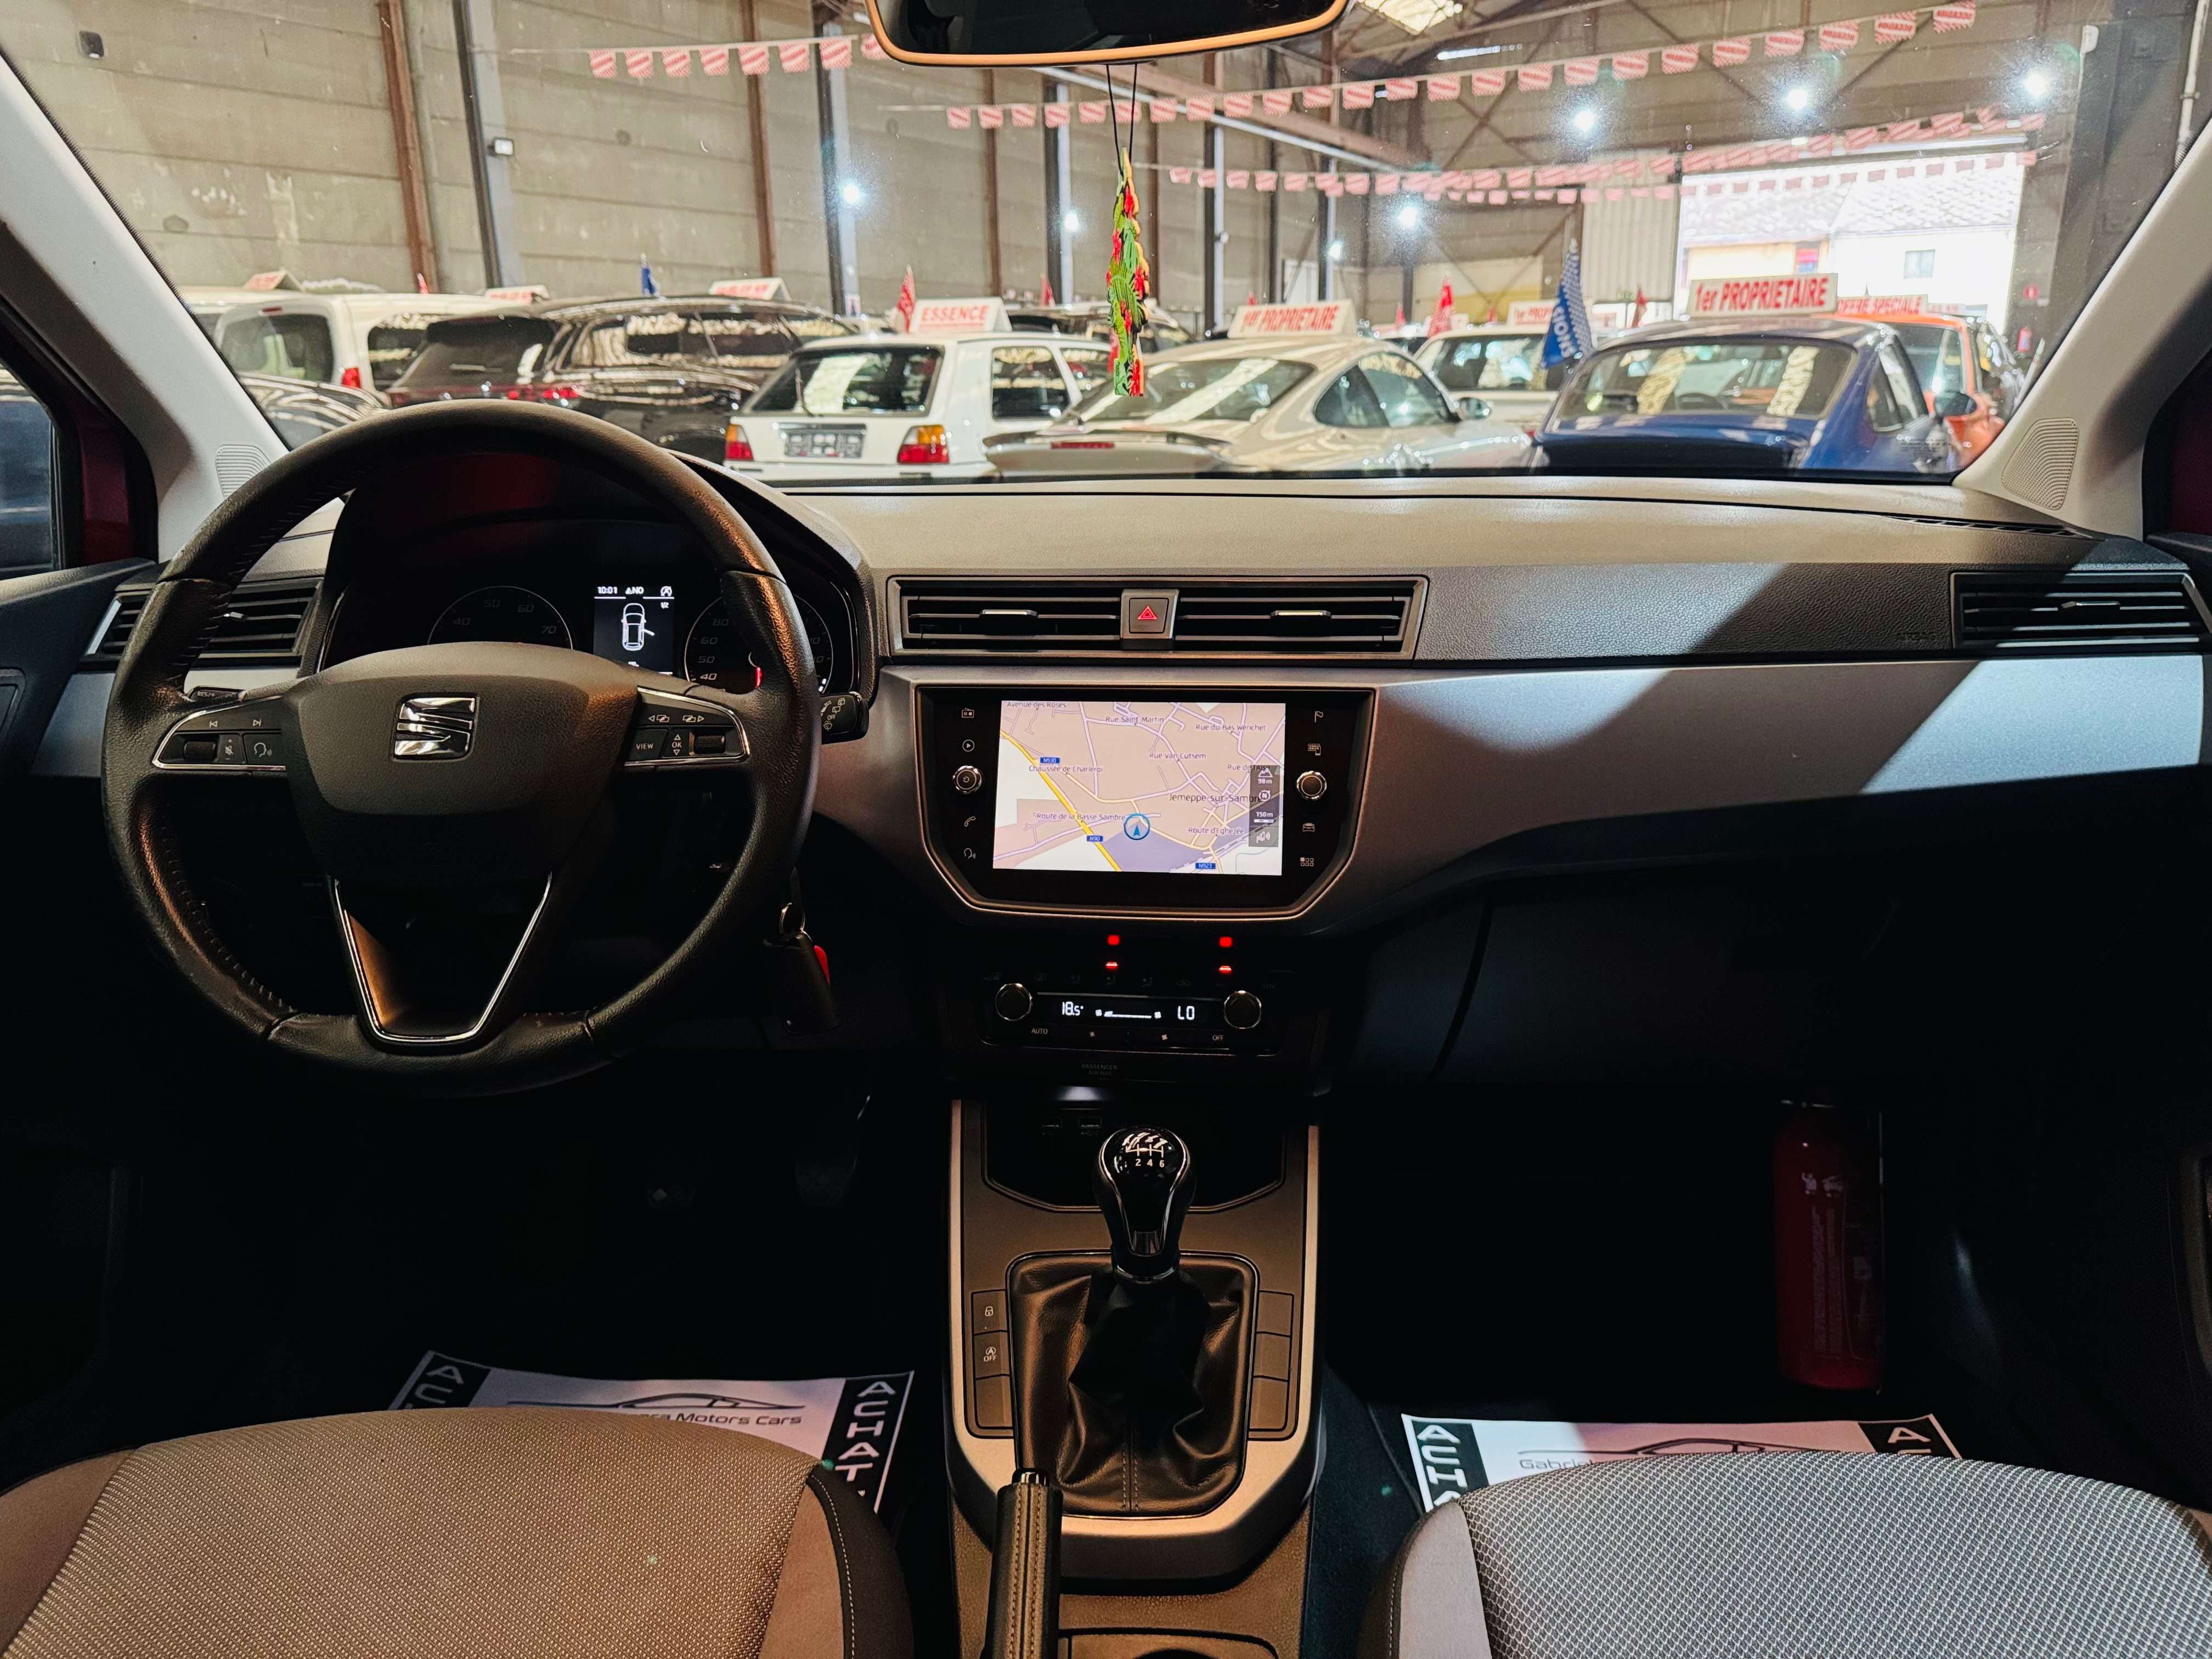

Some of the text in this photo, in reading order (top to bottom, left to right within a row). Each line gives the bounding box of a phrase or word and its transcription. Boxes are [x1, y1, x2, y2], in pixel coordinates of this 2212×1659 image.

[1695, 278, 1829, 311] 1er PROPRIETAIRE
[922, 305, 989, 321] ESSENCE
[1257, 305, 1339, 332] PROPRIETAIRE
[597, 586, 618, 594] 10:01
[483, 599, 500, 608] 50
[1168, 794, 1262, 803] Jemeppe-sur-Sambre
[1031, 1027, 1048, 1035] AUTO
[1147, 1159, 1154, 1167] 4
[1159, 1159, 1165, 1168] 6
[983, 1354, 997, 1362] OFF
[676, 1413, 751, 1425] Motors
[755, 1415, 802, 1425] Cars
